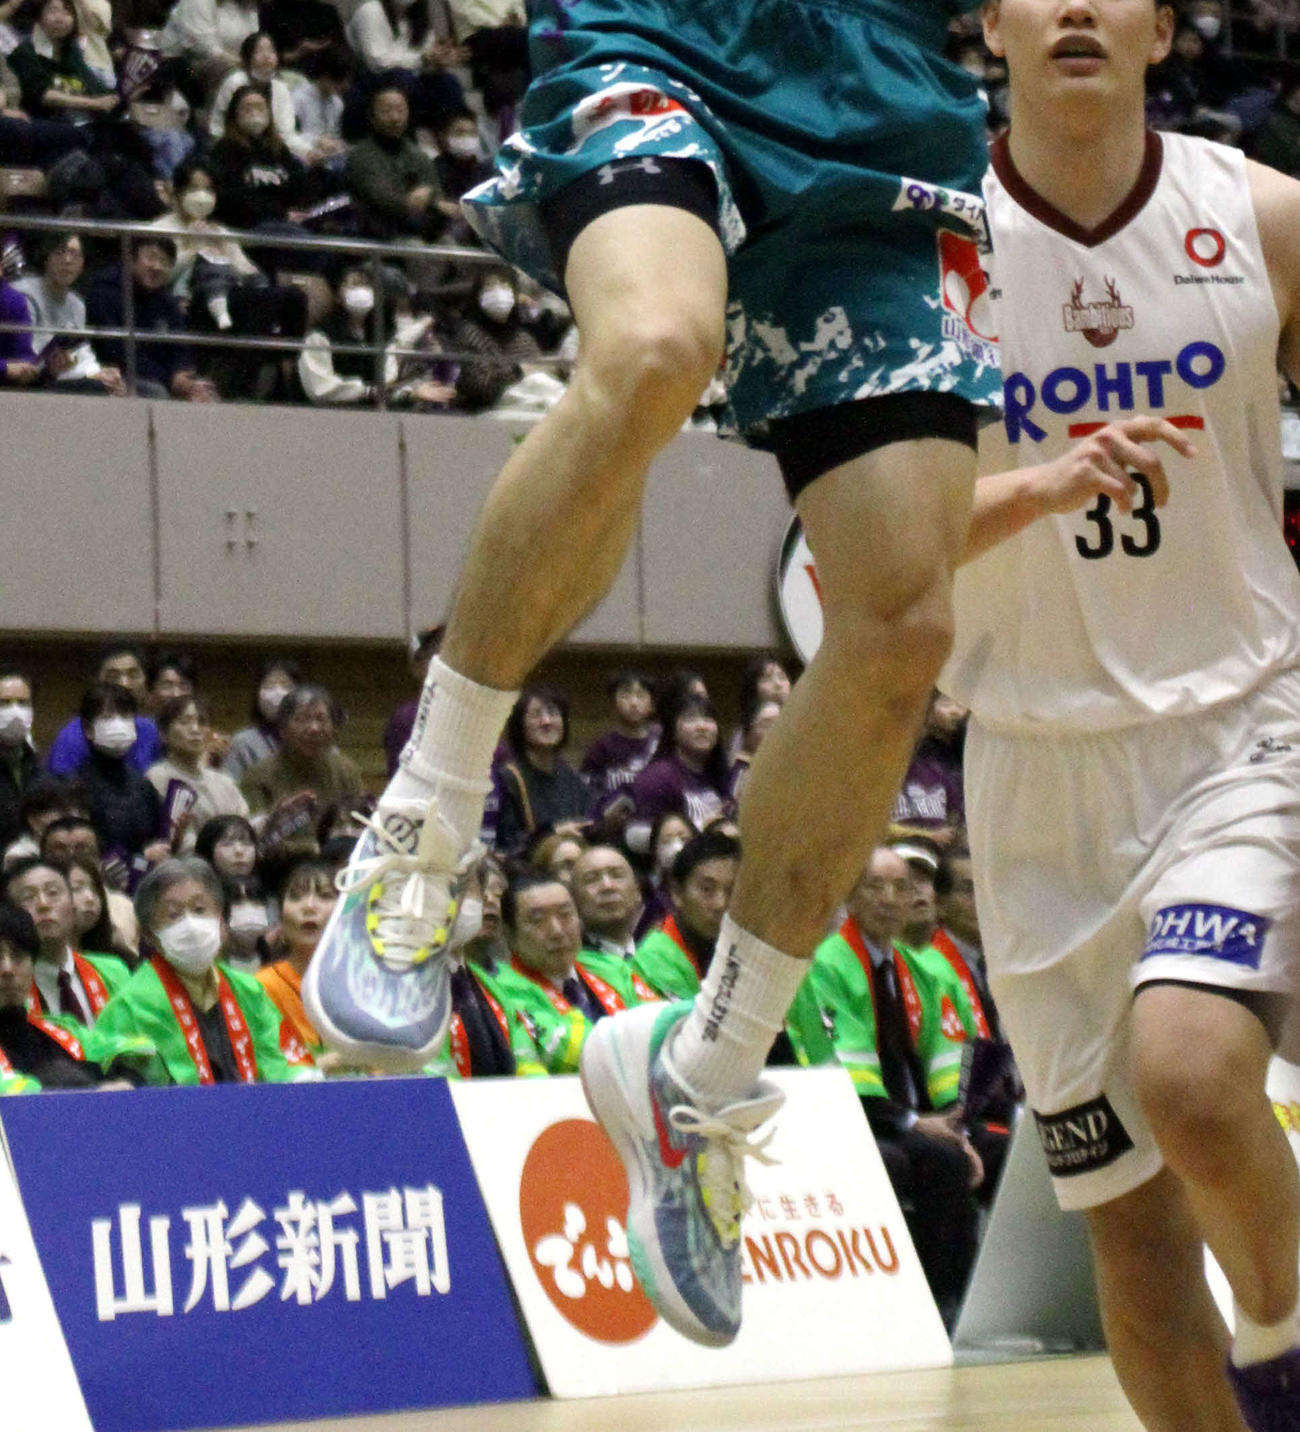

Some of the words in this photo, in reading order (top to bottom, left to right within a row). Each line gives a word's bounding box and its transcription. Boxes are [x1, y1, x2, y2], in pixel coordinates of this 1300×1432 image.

[1003, 341, 1226, 445] ROHTO
[1075, 472, 1161, 560] 33
[743, 1191, 844, 1221] に生きる
[91, 1183, 451, 1321] 山形新聞
[741, 1225, 900, 1286] NROKU
